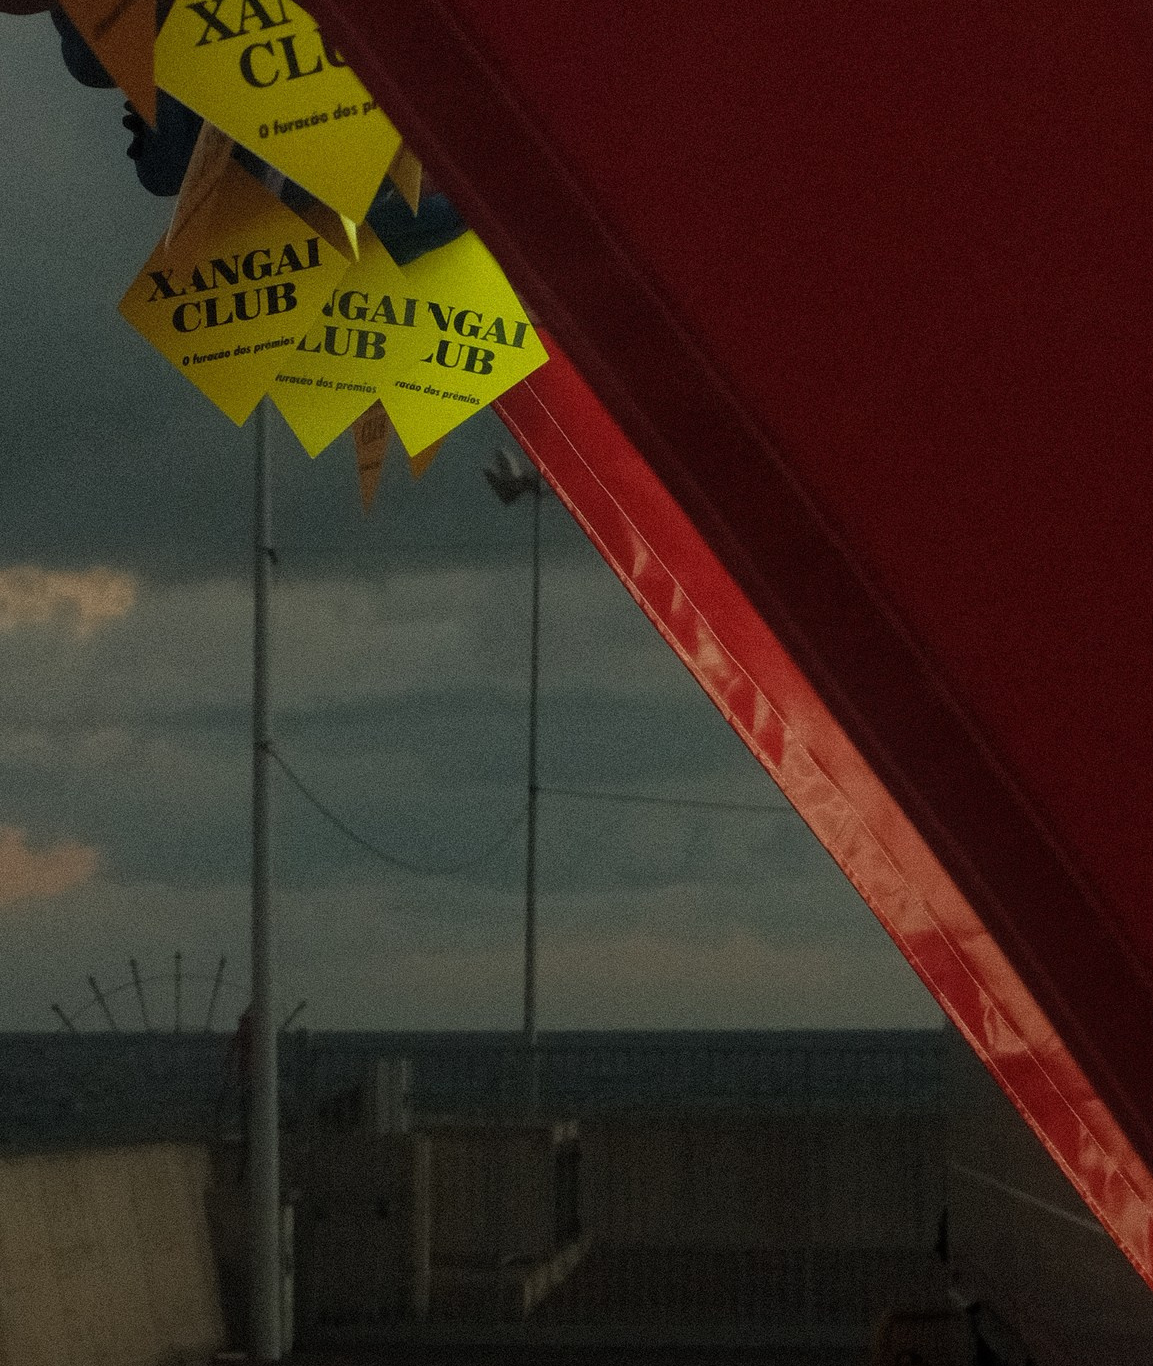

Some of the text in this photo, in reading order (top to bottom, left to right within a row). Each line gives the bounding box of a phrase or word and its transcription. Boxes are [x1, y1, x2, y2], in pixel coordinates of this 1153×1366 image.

[333, 103, 358, 120] dos
[148, 237, 322, 302] XANGAI
[172, 282, 297, 332] CLUB
[427, 301, 530, 349] NGAI
[233, 344, 251, 357] dos
[316, 376, 333, 388] dos
[423, 384, 440, 396] dos
